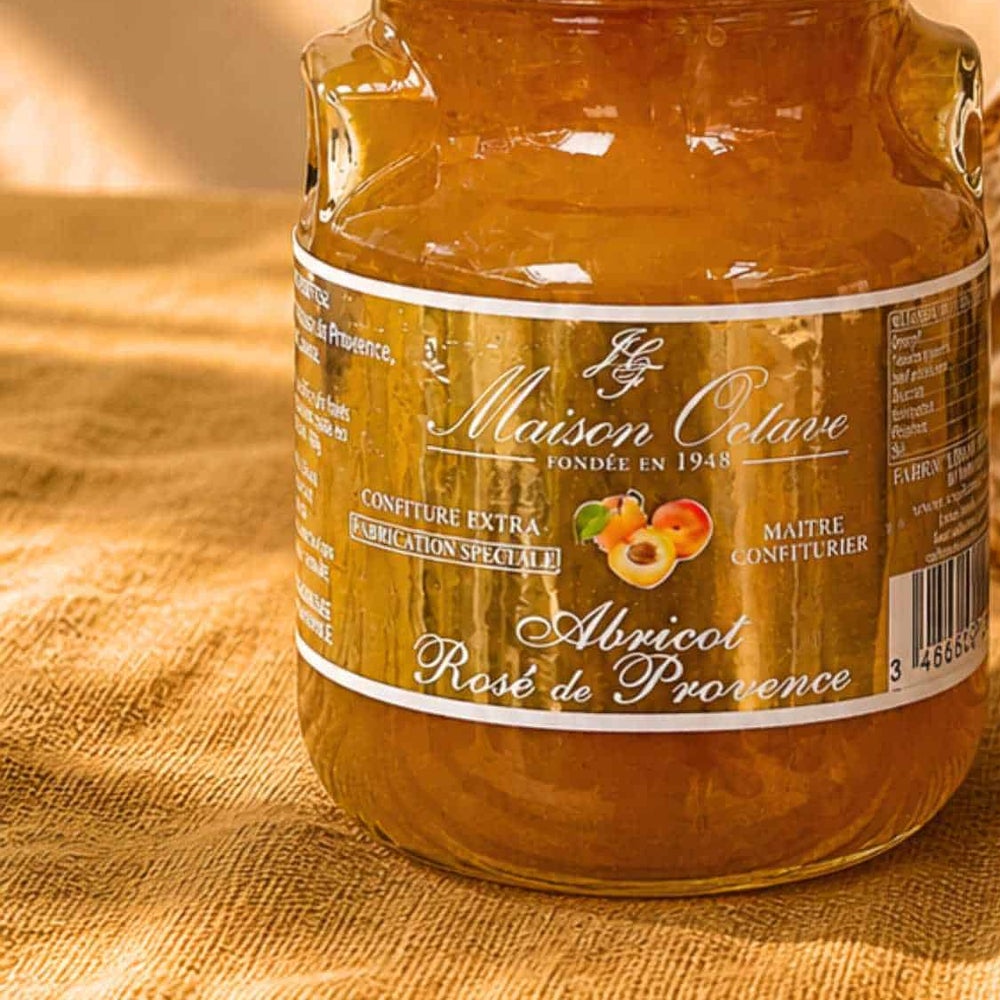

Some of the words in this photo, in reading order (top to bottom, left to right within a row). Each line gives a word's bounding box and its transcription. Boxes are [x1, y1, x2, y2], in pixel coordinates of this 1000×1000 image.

[427, 364, 654, 447] Maison
[546, 454, 629, 472] FONDÉE
[639, 457, 666, 472] EN
[677, 451, 731, 472] 1948
[360, 488, 460, 528] CONFITURE
[466, 510, 540, 537] EXTRA
[351, 517, 456, 557] FABRICATION
[459, 543, 557, 569] SPECIALE
[731, 534, 869, 566] CONFITURIER
[515, 600, 751, 652] Abricot
[412, 632, 538, 700] Rosé
[549, 669, 594, 703] de
[612, 653, 852, 705] Provence
[890, 658, 902, 682] 3
